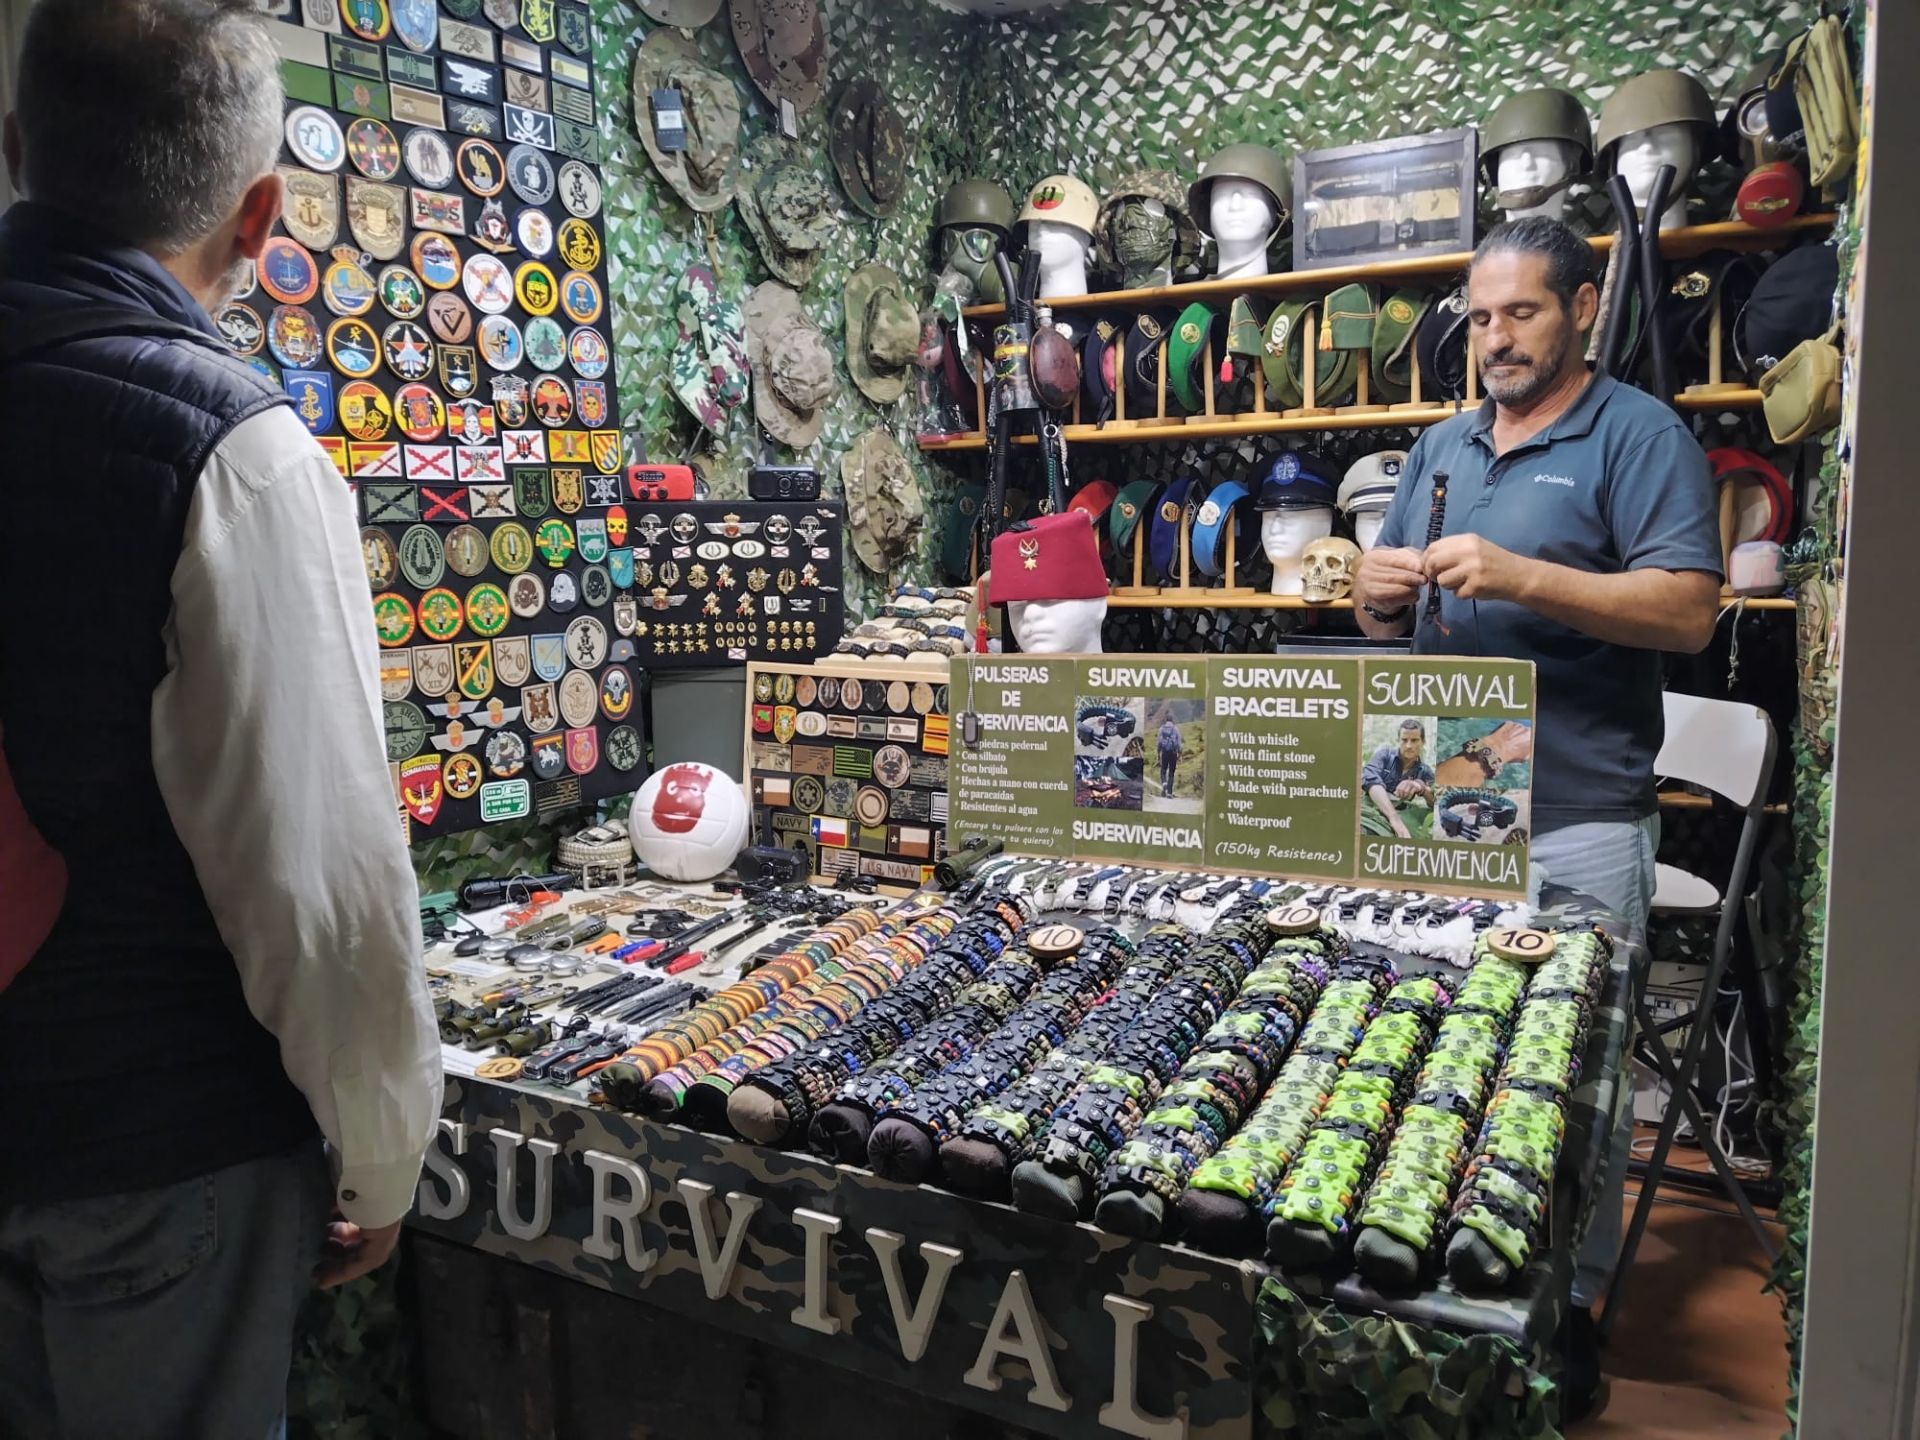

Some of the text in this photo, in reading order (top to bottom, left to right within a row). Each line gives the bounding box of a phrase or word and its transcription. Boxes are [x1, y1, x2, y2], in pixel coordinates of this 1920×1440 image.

[1543, 474, 1575, 487] Columbia
[974, 666, 1049, 684] PULSERAS
[1088, 668, 1196, 689] SURVIVAL
[1222, 667, 1341, 690] SURVIVAL
[1001, 690, 1021, 707] DE
[1367, 671, 1528, 710] SURVIVAL
[1214, 696, 1349, 720] BRACELETS
[955, 715, 1069, 733] SPERVIVENCIA
[979, 738, 1009, 750] piedras
[1011, 740, 1048, 752] pedernal
[1228, 731, 1299, 747] With whistle
[961, 751, 1006, 762] Con silbato
[1228, 748, 1315, 764] With flint stone
[961, 763, 977, 773] Con
[1228, 764, 1307, 781] With compass
[961, 776, 991, 787] Hechas
[999, 780, 1022, 788] mano
[1039, 780, 1068, 791] cuerda
[1227, 780, 1349, 800] Made with parachute
[959, 788, 970, 798] de
[960, 801, 1038, 817] Resistentes al agua
[1227, 799, 1253, 811] rope
[776, 818, 802, 828] NAVY
[1004, 823, 1032, 833] pulsera
[1035, 825, 1049, 834] con
[1052, 826, 1064, 835] los
[1227, 813, 1292, 830] Waterproof
[1072, 820, 1202, 849] SUPERVIVENCIA
[1214, 841, 1343, 864] (150kg Resistence)
[866, 861, 917, 878] U.S. NAVY
[1363, 842, 1520, 885] SUPERVIVENCIA
[1278, 907, 1314, 924] 10
[1035, 928, 1077, 947] 10
[1500, 930, 1544, 950] 10
[482, 1062, 517, 1074] 10
[419, 1118, 1189, 1440] SURVIVAL
